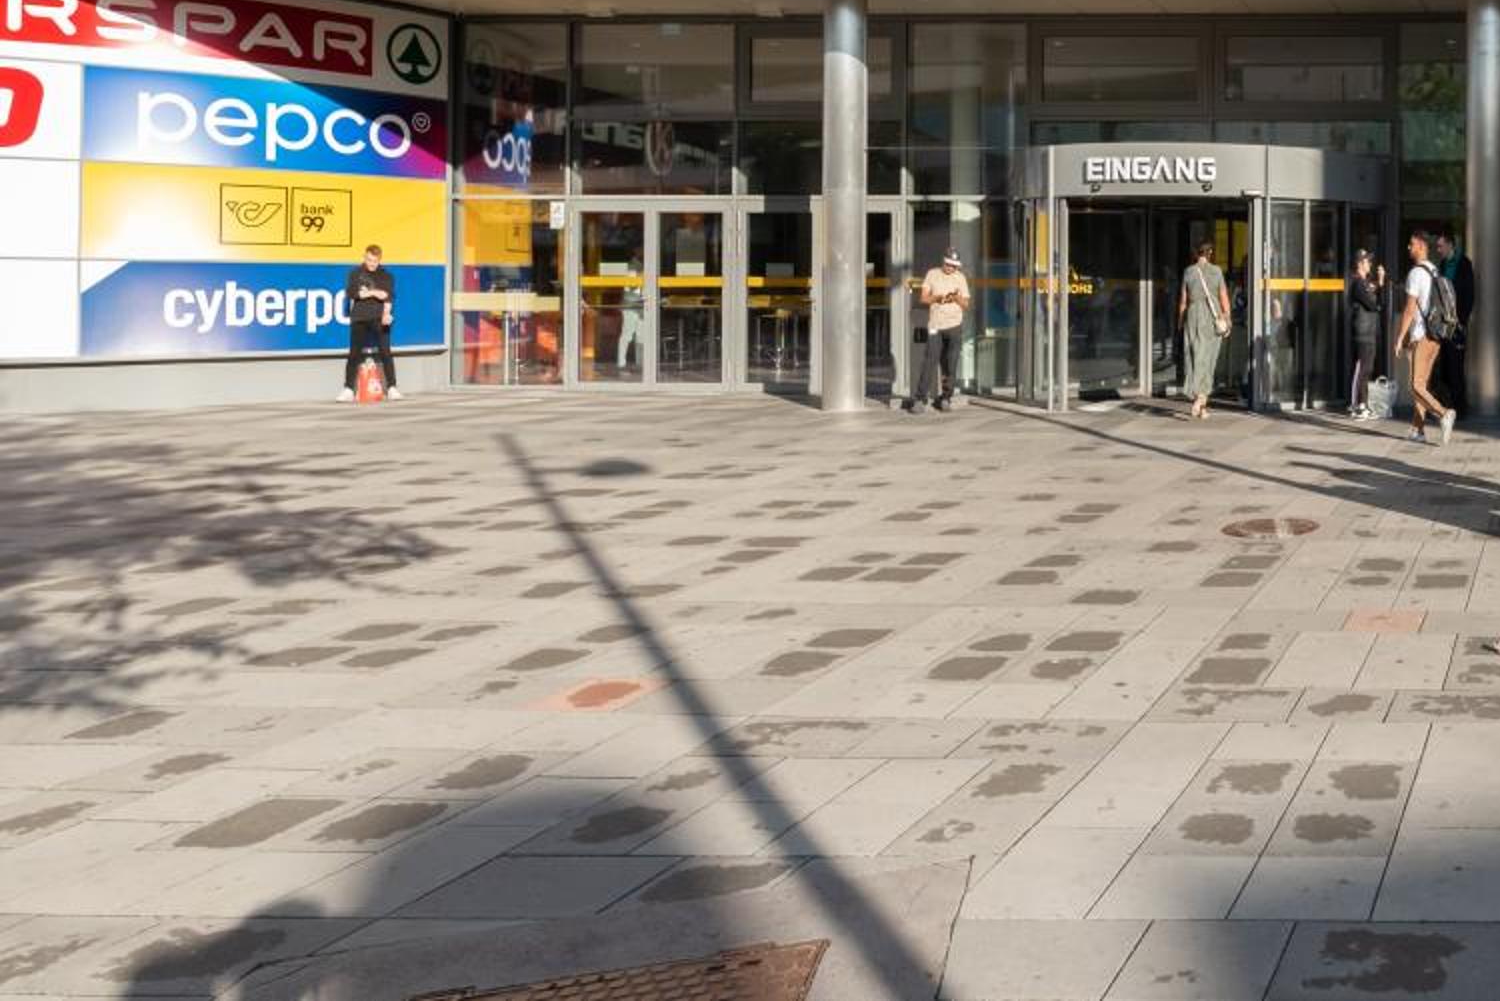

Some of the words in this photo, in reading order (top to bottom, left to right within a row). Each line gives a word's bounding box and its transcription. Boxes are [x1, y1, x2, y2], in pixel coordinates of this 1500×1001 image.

[137, 91, 413, 162] pepco
[1083, 156, 1217, 184] EINGANG
[300, 203, 335, 216] bank
[300, 215, 325, 233] 99
